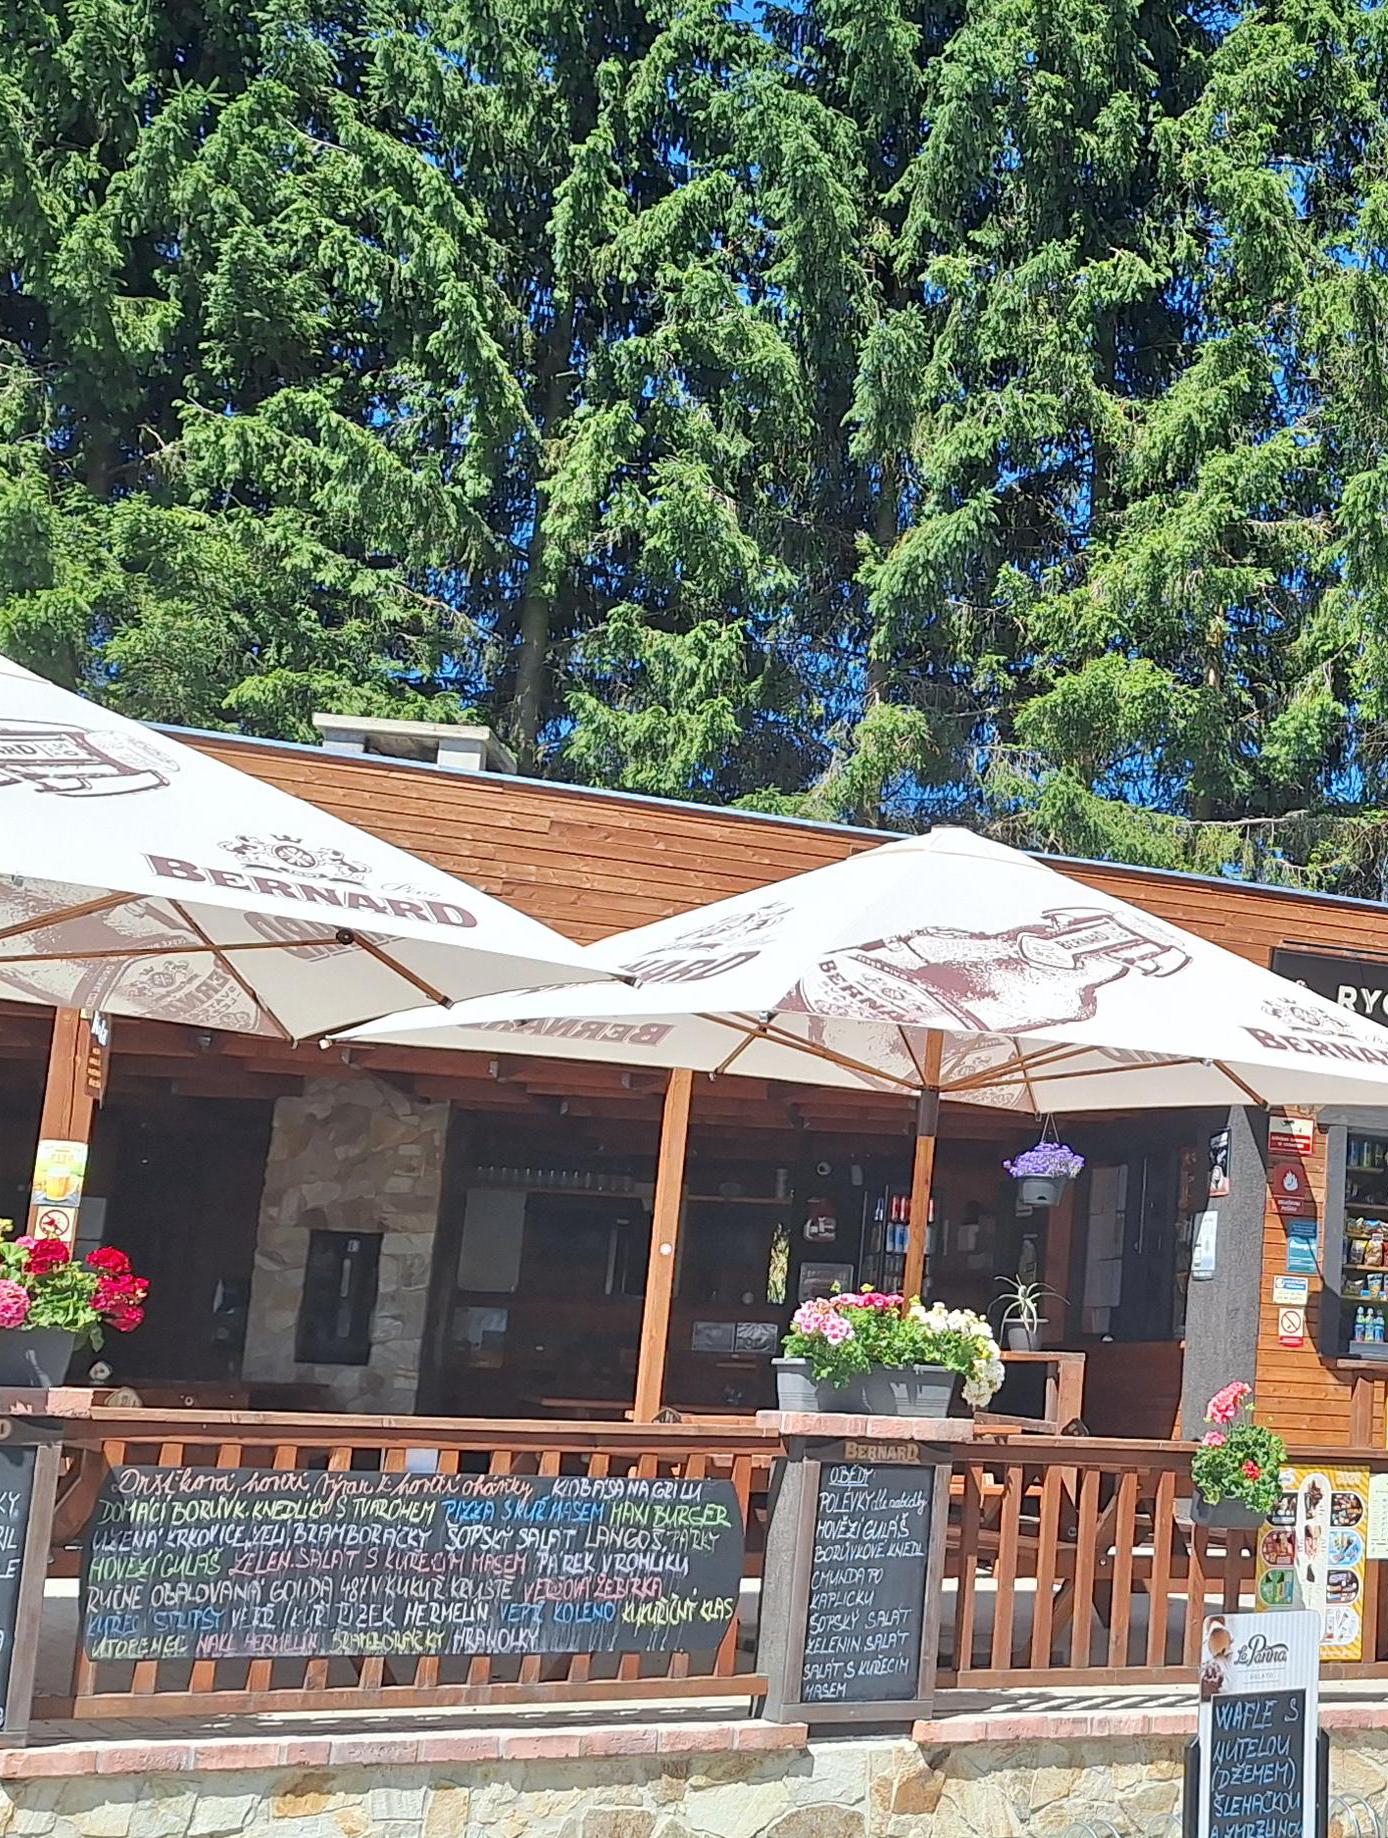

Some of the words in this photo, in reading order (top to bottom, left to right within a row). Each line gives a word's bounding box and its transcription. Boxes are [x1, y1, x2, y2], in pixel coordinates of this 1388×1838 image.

[143, 854, 477, 928] BERNARD
[1055, 931, 1110, 950] BERNARD
[844, 1441, 920, 1463] BERNARD
[627, 1479, 650, 1500] NA
[352, 1498, 436, 1526] TVAROHEM
[442, 1500, 495, 1522] PIZZA
[610, 1501, 649, 1528] MAXI
[652, 1503, 732, 1529] BURGER
[516, 1527, 577, 1551] SALÁT
[270, 1576, 334, 1608] GOUDA
[403, 1598, 489, 1627] HERMELÍN
[554, 1601, 616, 1624] KOLENO
[700, 1597, 735, 1623] KLAS
[864, 1603, 913, 1630] SALÁT
[453, 1625, 541, 1653] HRANOLKY
[864, 1628, 910, 1652] SALÁT
[1247, 1633, 1290, 1667] Panna
[803, 1657, 844, 1680] SALÁT
[844, 1660, 856, 1679] S
[1284, 1697, 1300, 1722] S
[1213, 1735, 1291, 1765] NUTELOU
[1213, 1790, 1302, 1818] ŠLEHAČKOU
